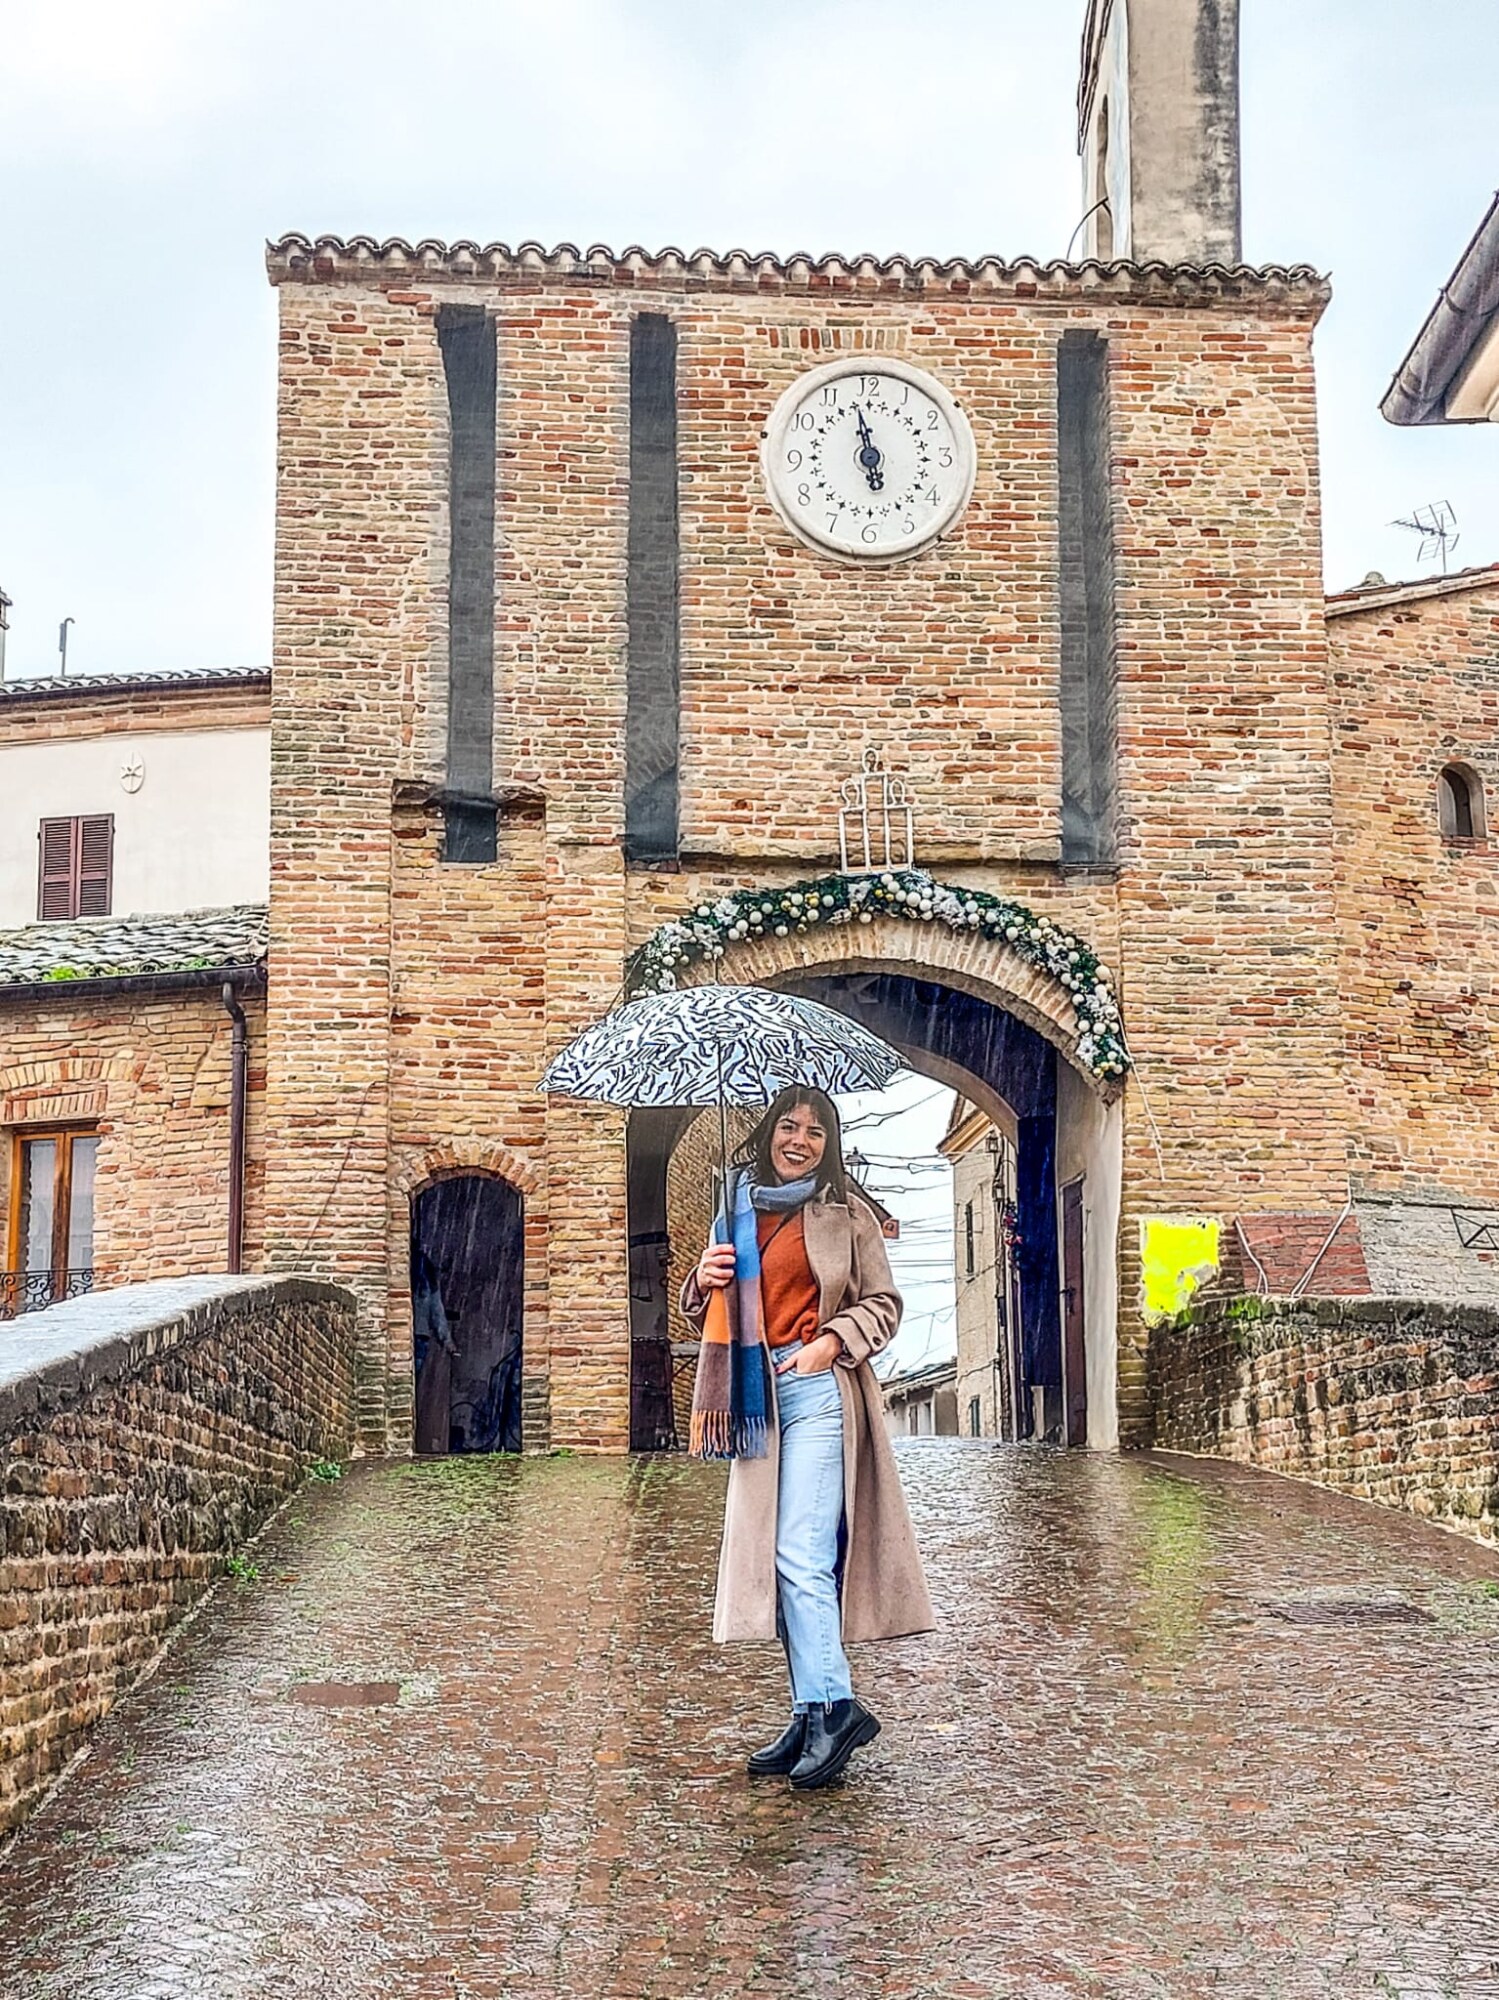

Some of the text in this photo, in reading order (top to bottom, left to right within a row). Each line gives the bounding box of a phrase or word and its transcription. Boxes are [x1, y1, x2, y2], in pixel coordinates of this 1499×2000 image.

[927, 410, 939, 431] 2
[786, 449, 803, 473] 9
[938, 447, 953, 468] 3
[797, 482, 811, 506] 8
[925, 483, 941, 507] 4
[825, 512, 838, 534] 7
[861, 523, 879, 544] 6
[901, 512, 915, 534] 5
